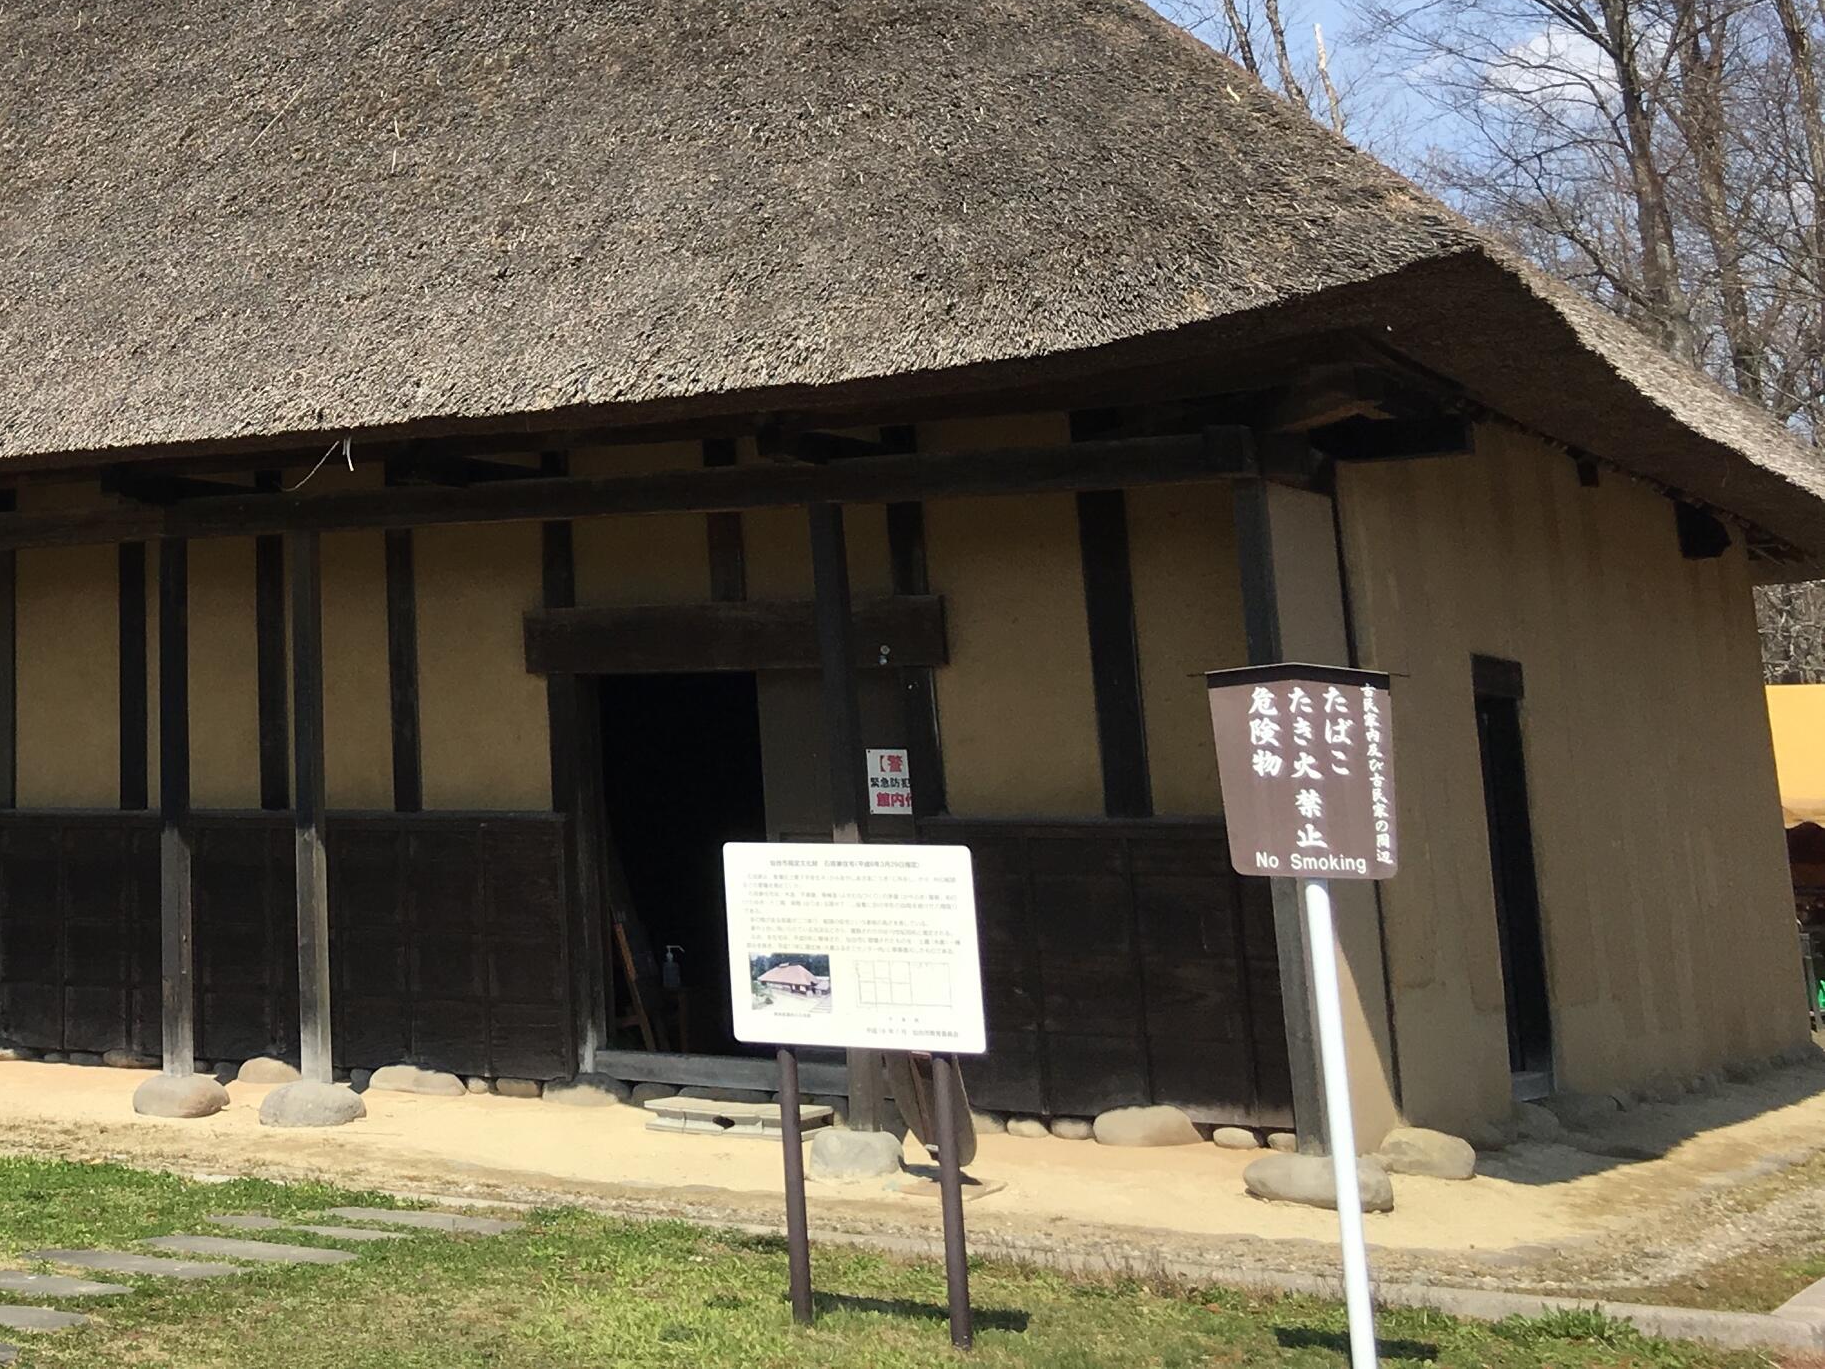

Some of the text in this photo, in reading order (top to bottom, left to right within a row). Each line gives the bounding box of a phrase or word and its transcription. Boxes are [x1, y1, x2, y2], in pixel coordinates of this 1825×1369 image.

[1248, 686, 1283, 777] 危険物
[1288, 686, 1329, 848] たき火 禁止
[1322, 686, 1355, 775] たばこ
[1360, 683, 1394, 864] 古民家内及び古民家の周辺
[1255, 851, 1367, 873] No Smoking
